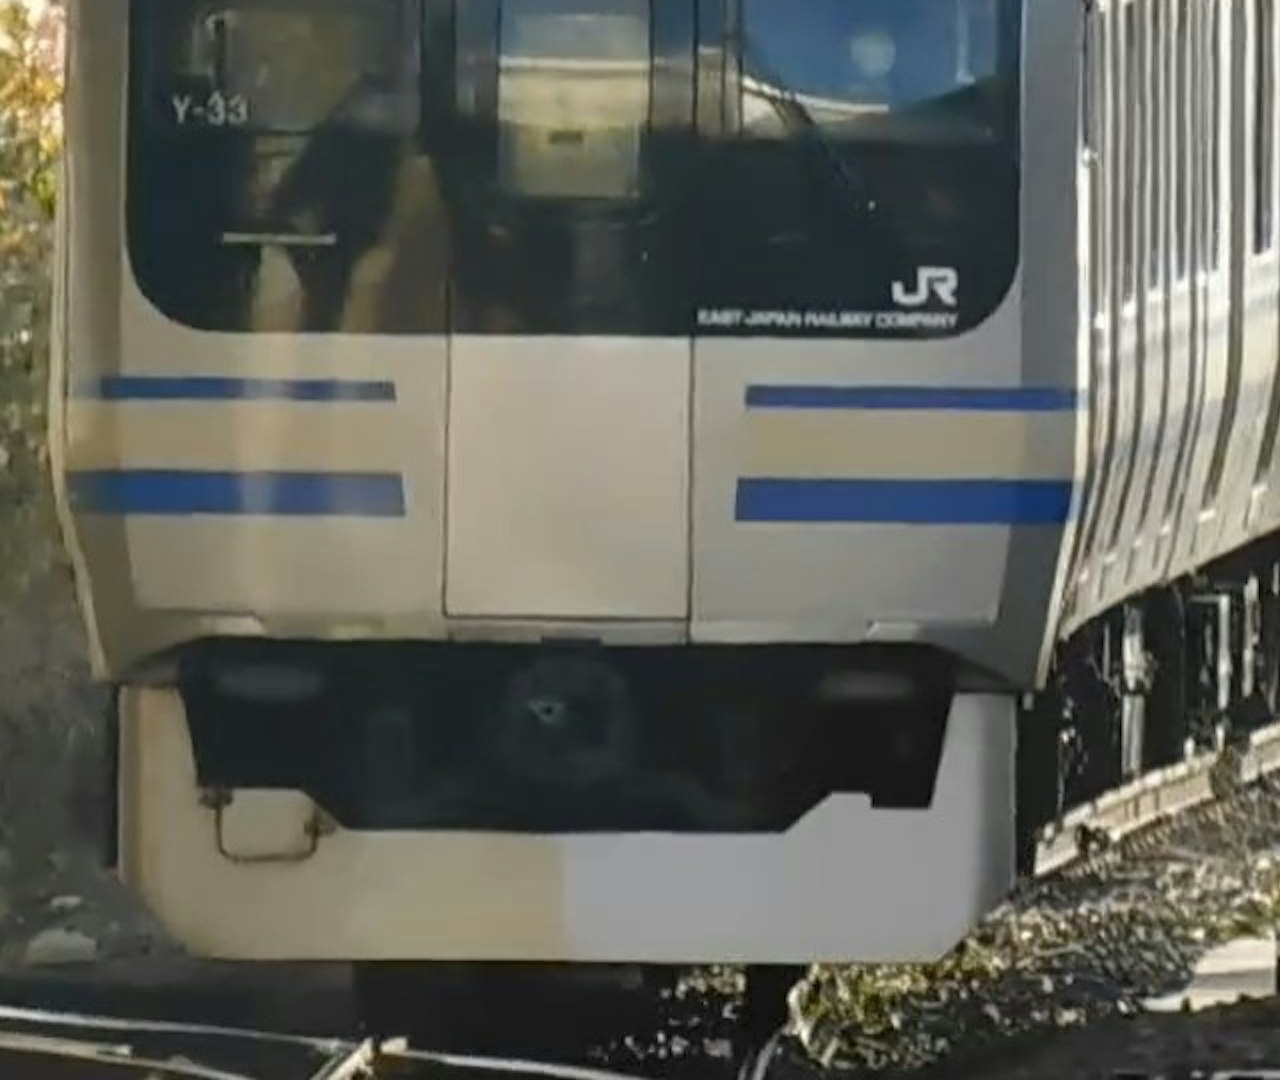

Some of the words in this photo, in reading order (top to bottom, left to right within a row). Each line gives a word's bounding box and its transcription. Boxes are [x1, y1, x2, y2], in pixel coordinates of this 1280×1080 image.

[172, 90, 248, 127] Y-33
[890, 265, 959, 307] JR
[697, 308, 743, 326] EAST
[745, 309, 803, 327] JAPAN
[805, 310, 874, 328] RAILWAY
[876, 311, 959, 329] COMPANY
